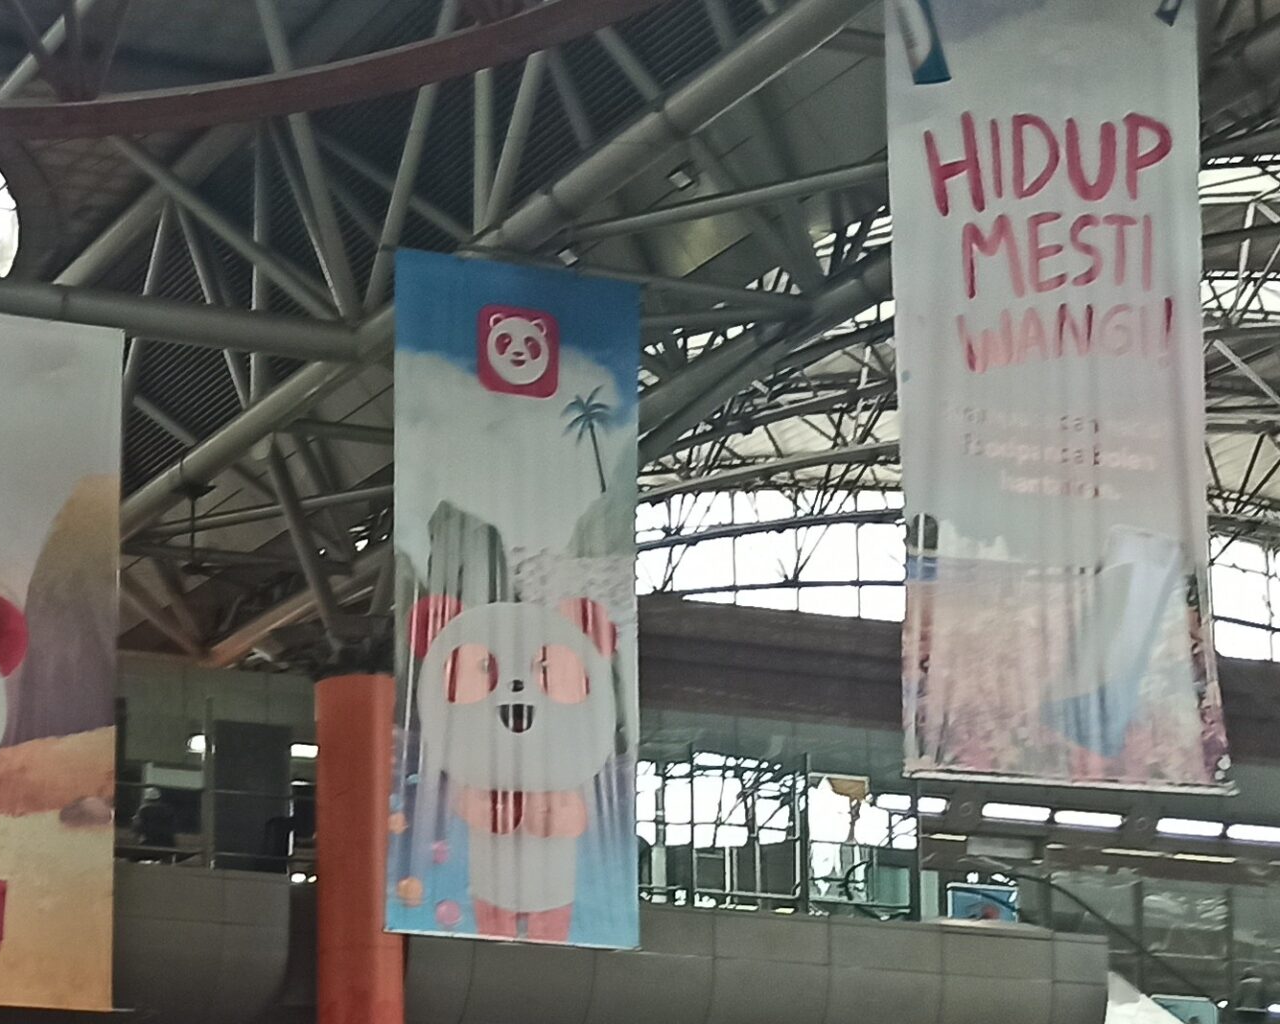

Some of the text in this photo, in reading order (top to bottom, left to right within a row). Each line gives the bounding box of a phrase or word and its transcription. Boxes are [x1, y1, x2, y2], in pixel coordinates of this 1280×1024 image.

[923, 110, 1173, 217] HIDUP
[961, 211, 1153, 299] MESTI
[956, 297, 1174, 374] WANGI!
